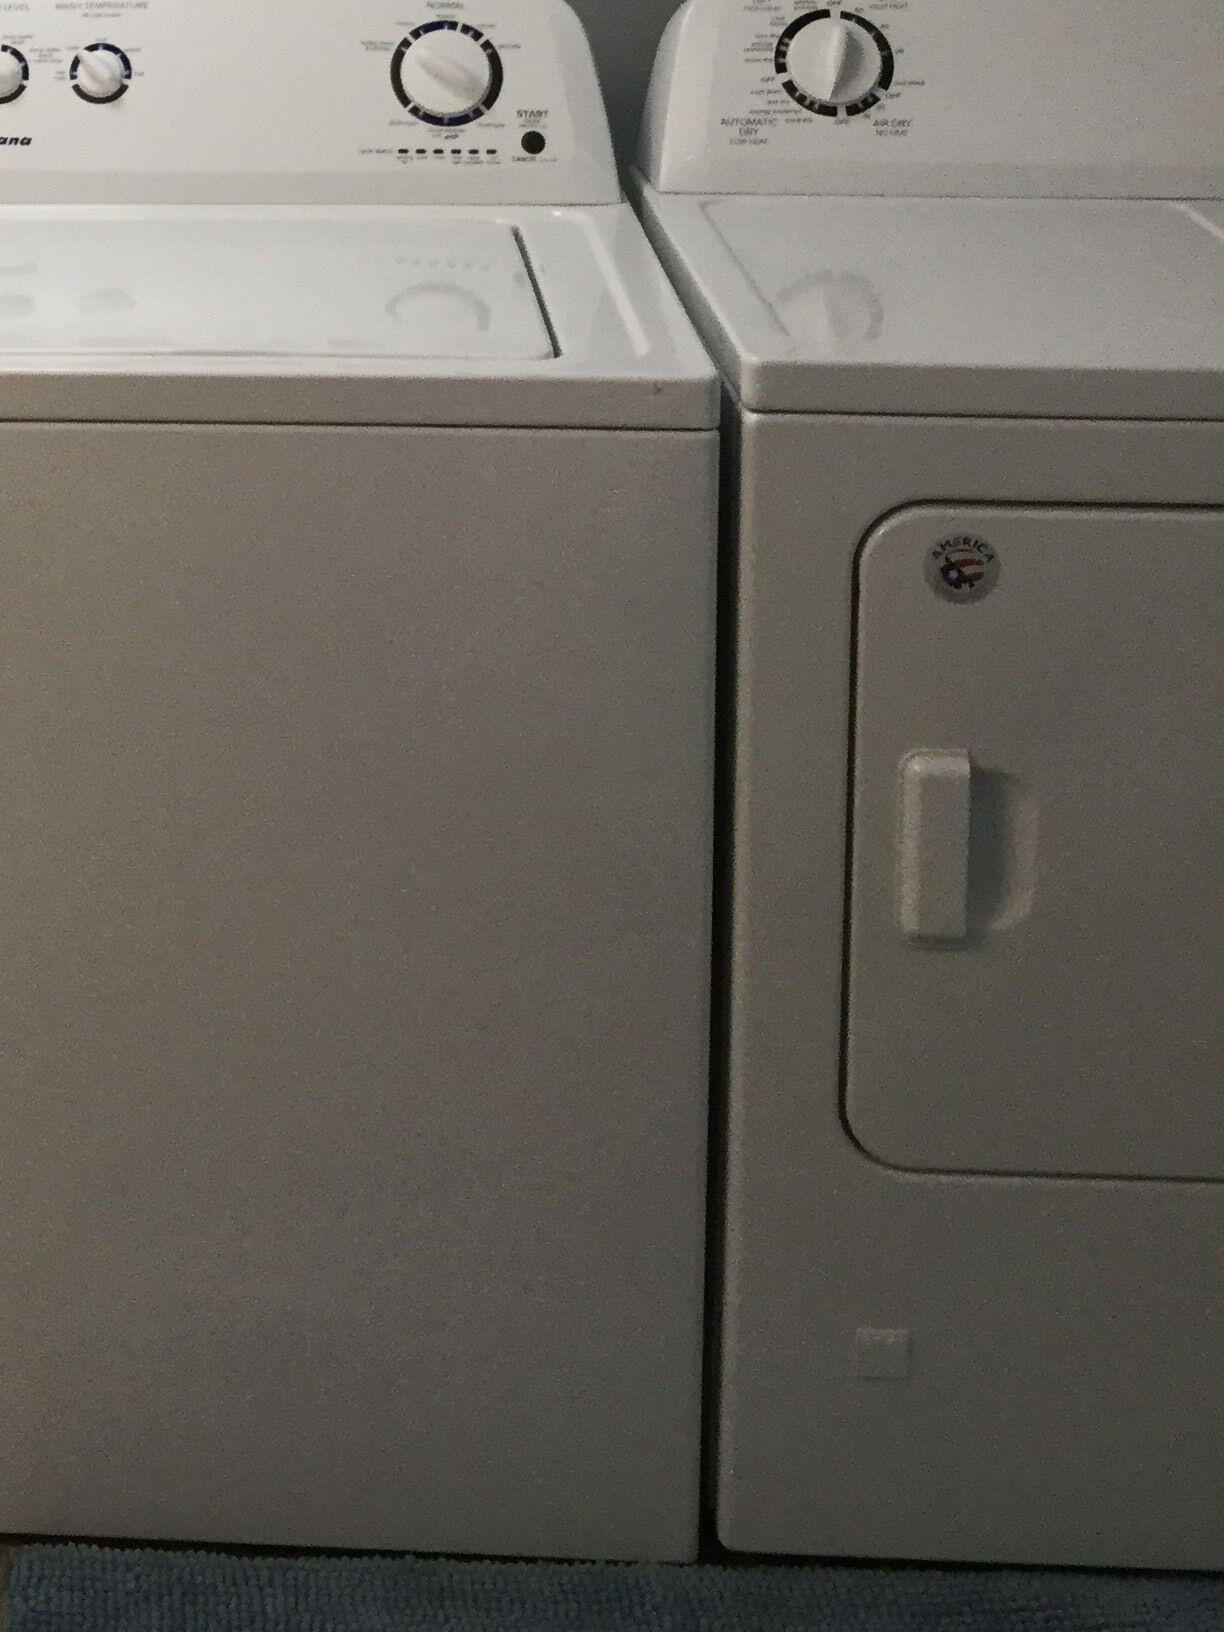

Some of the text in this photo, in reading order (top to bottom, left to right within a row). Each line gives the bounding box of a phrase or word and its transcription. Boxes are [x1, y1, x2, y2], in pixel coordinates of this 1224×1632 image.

[84, 1, 148, 9] TEMPERATURE
[516, 110, 549, 118] START
[720, 118, 778, 126] AUTOMATIC
[932, 536, 995, 563] AMERICA
